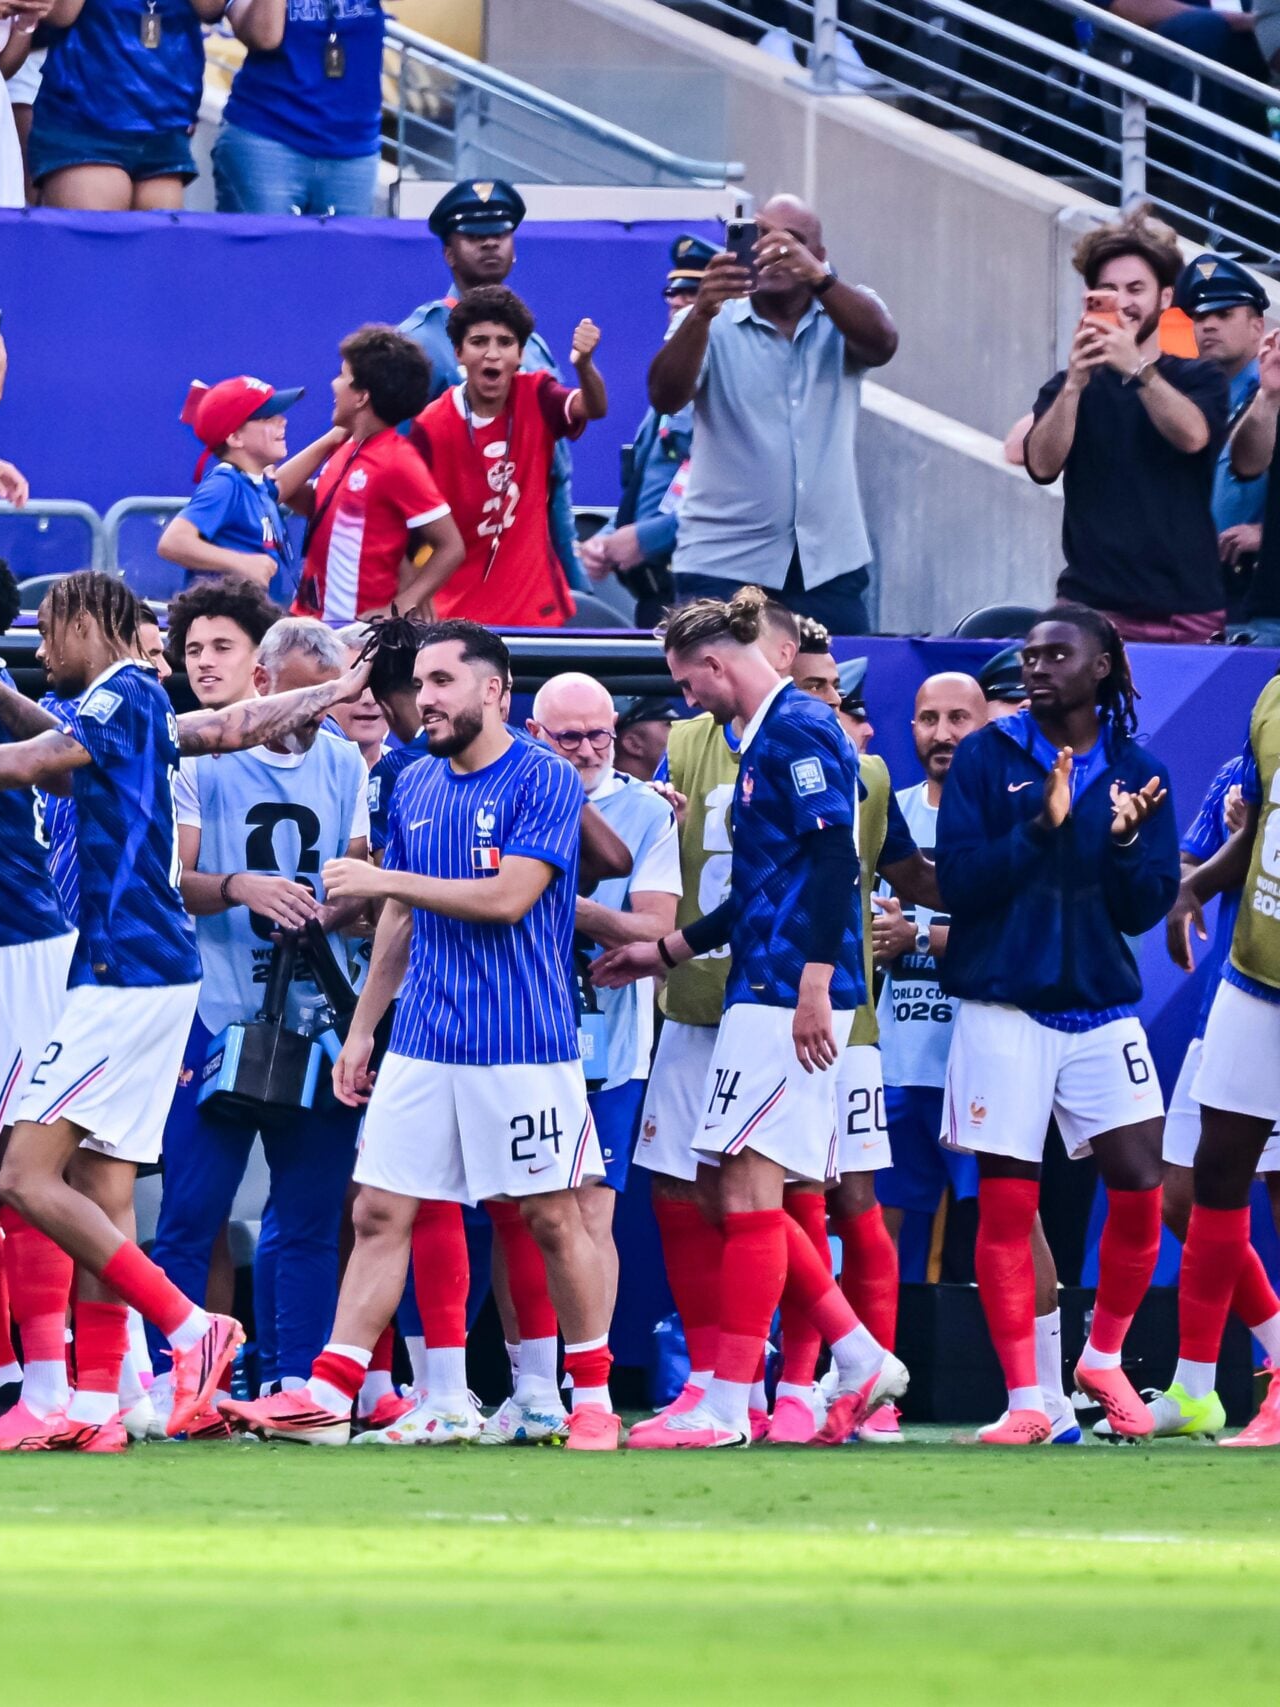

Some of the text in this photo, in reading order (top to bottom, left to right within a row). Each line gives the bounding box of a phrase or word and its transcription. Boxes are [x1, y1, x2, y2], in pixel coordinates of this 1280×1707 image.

[477, 482, 520, 537] 22
[901, 953, 936, 970] FIFA
[892, 986, 923, 1001] ORLD
[893, 1002, 953, 1023] 026
[1122, 1041, 1150, 1085] 6
[707, 1068, 741, 1115] 14
[509, 1106, 564, 1162] 24
